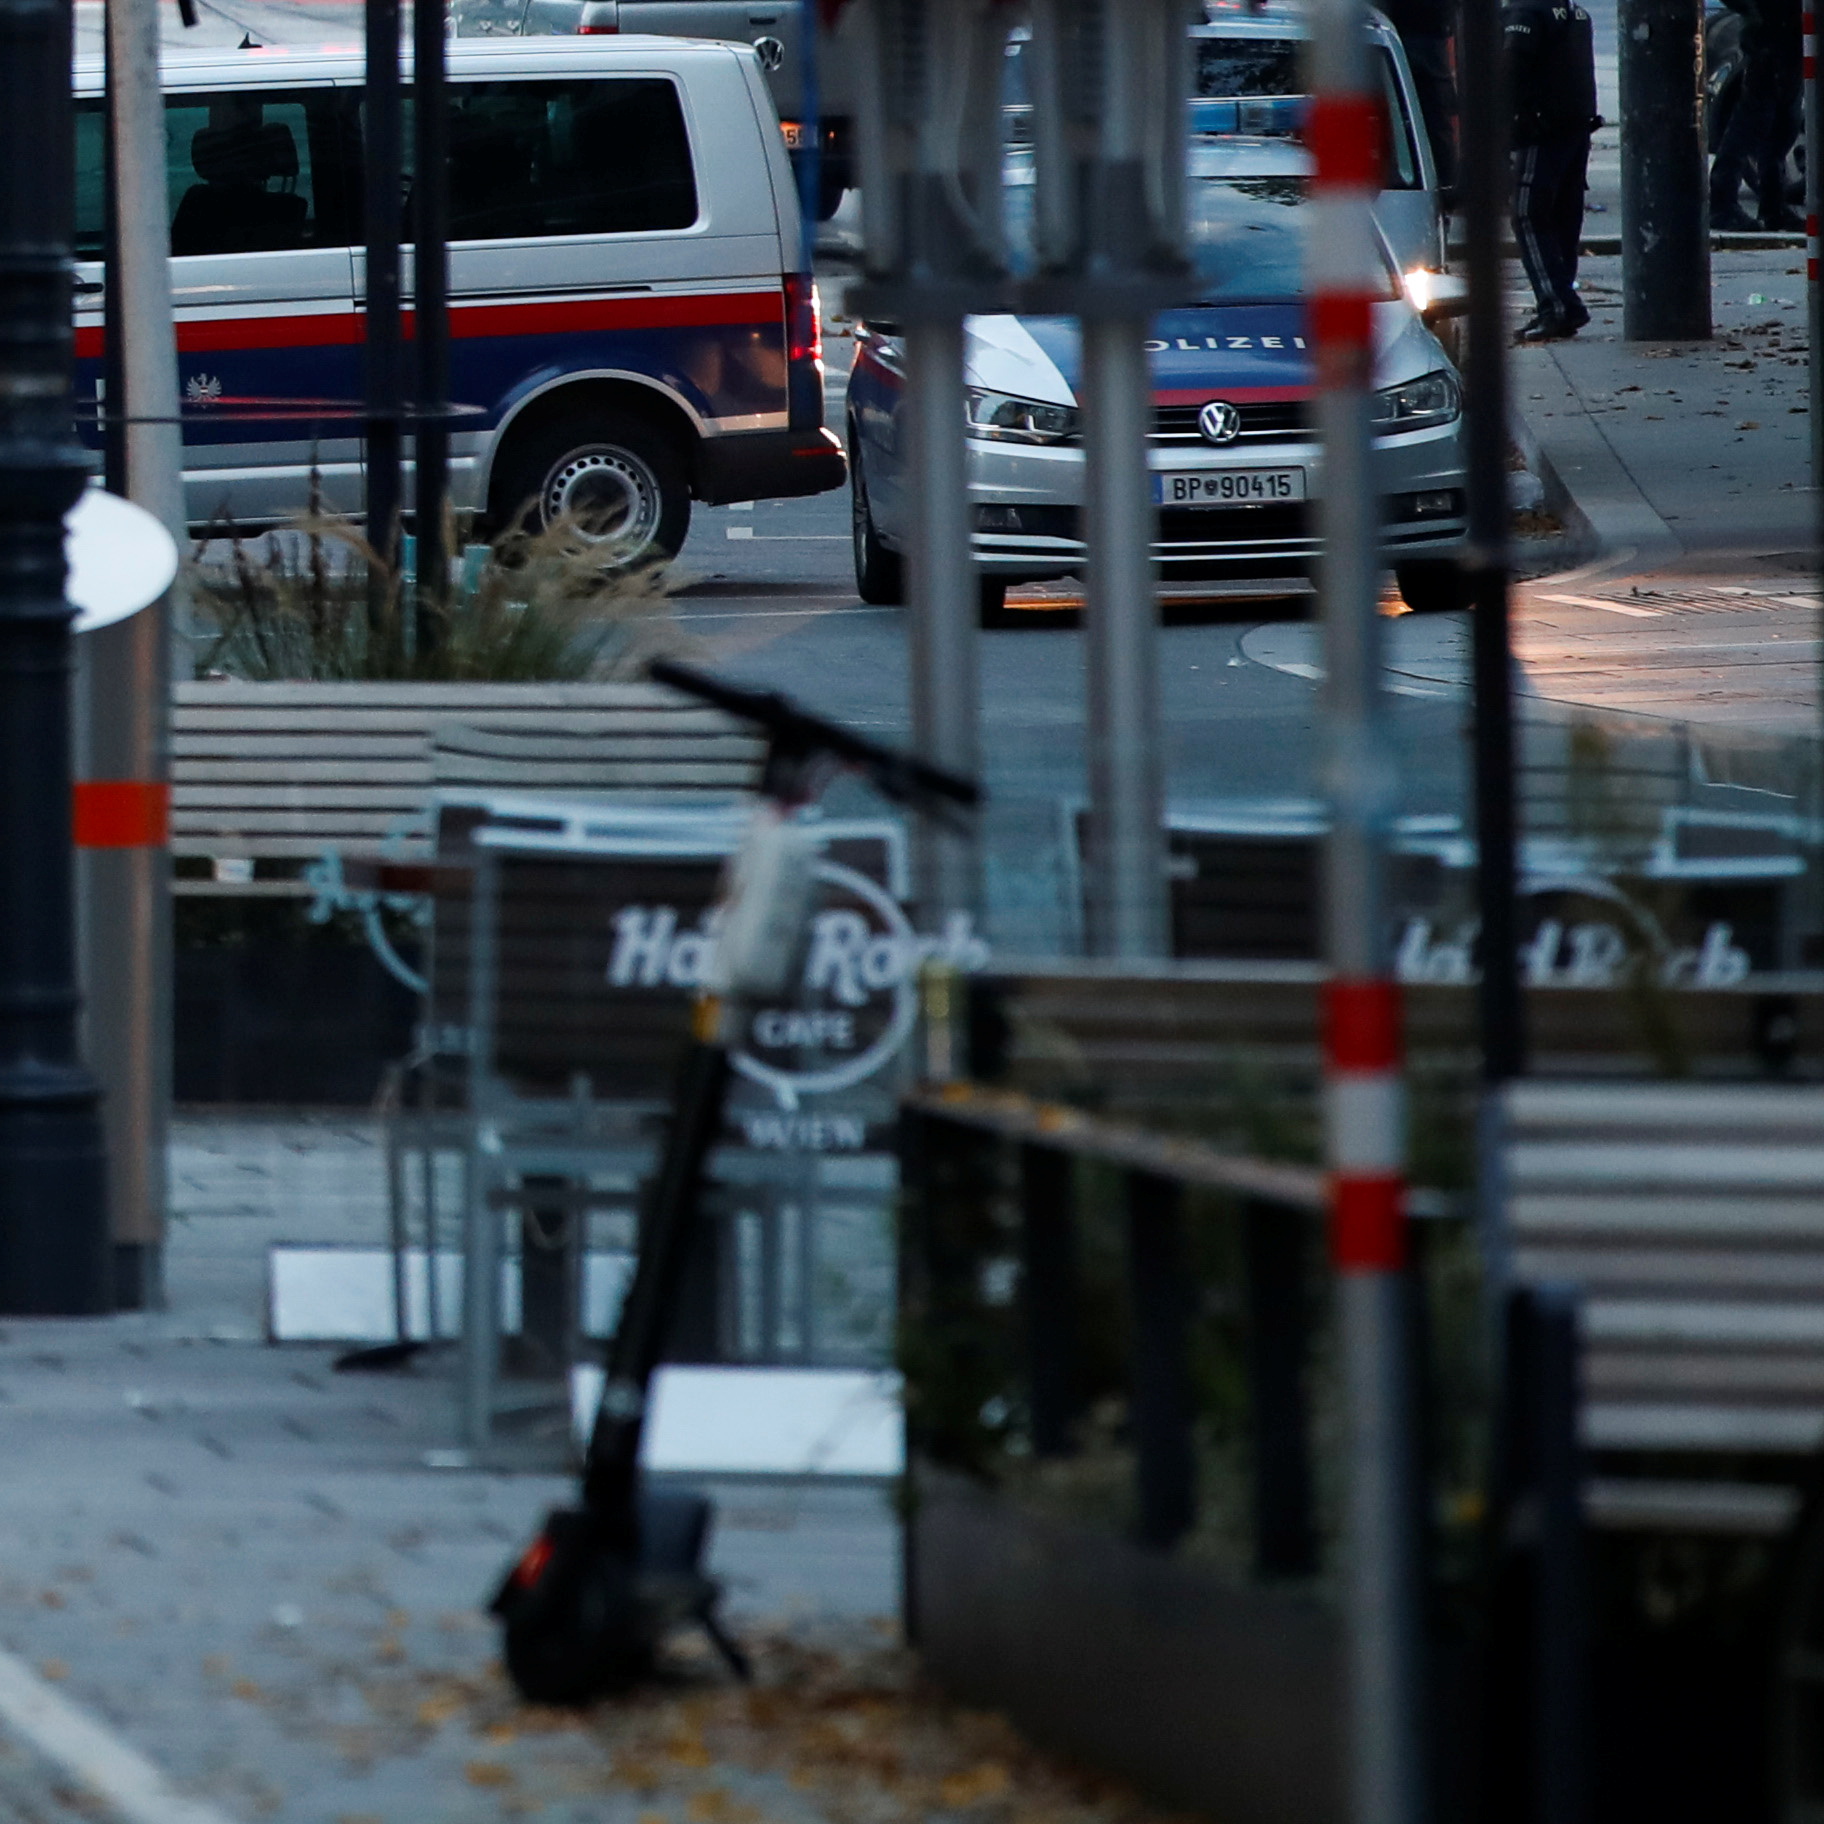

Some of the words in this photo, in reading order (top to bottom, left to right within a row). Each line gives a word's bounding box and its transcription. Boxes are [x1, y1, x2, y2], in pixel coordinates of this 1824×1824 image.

[1144, 336, 1306, 352] OLIZEI
[1220, 474, 1292, 500] 90415
[753, 1007, 856, 1049] CAFE
